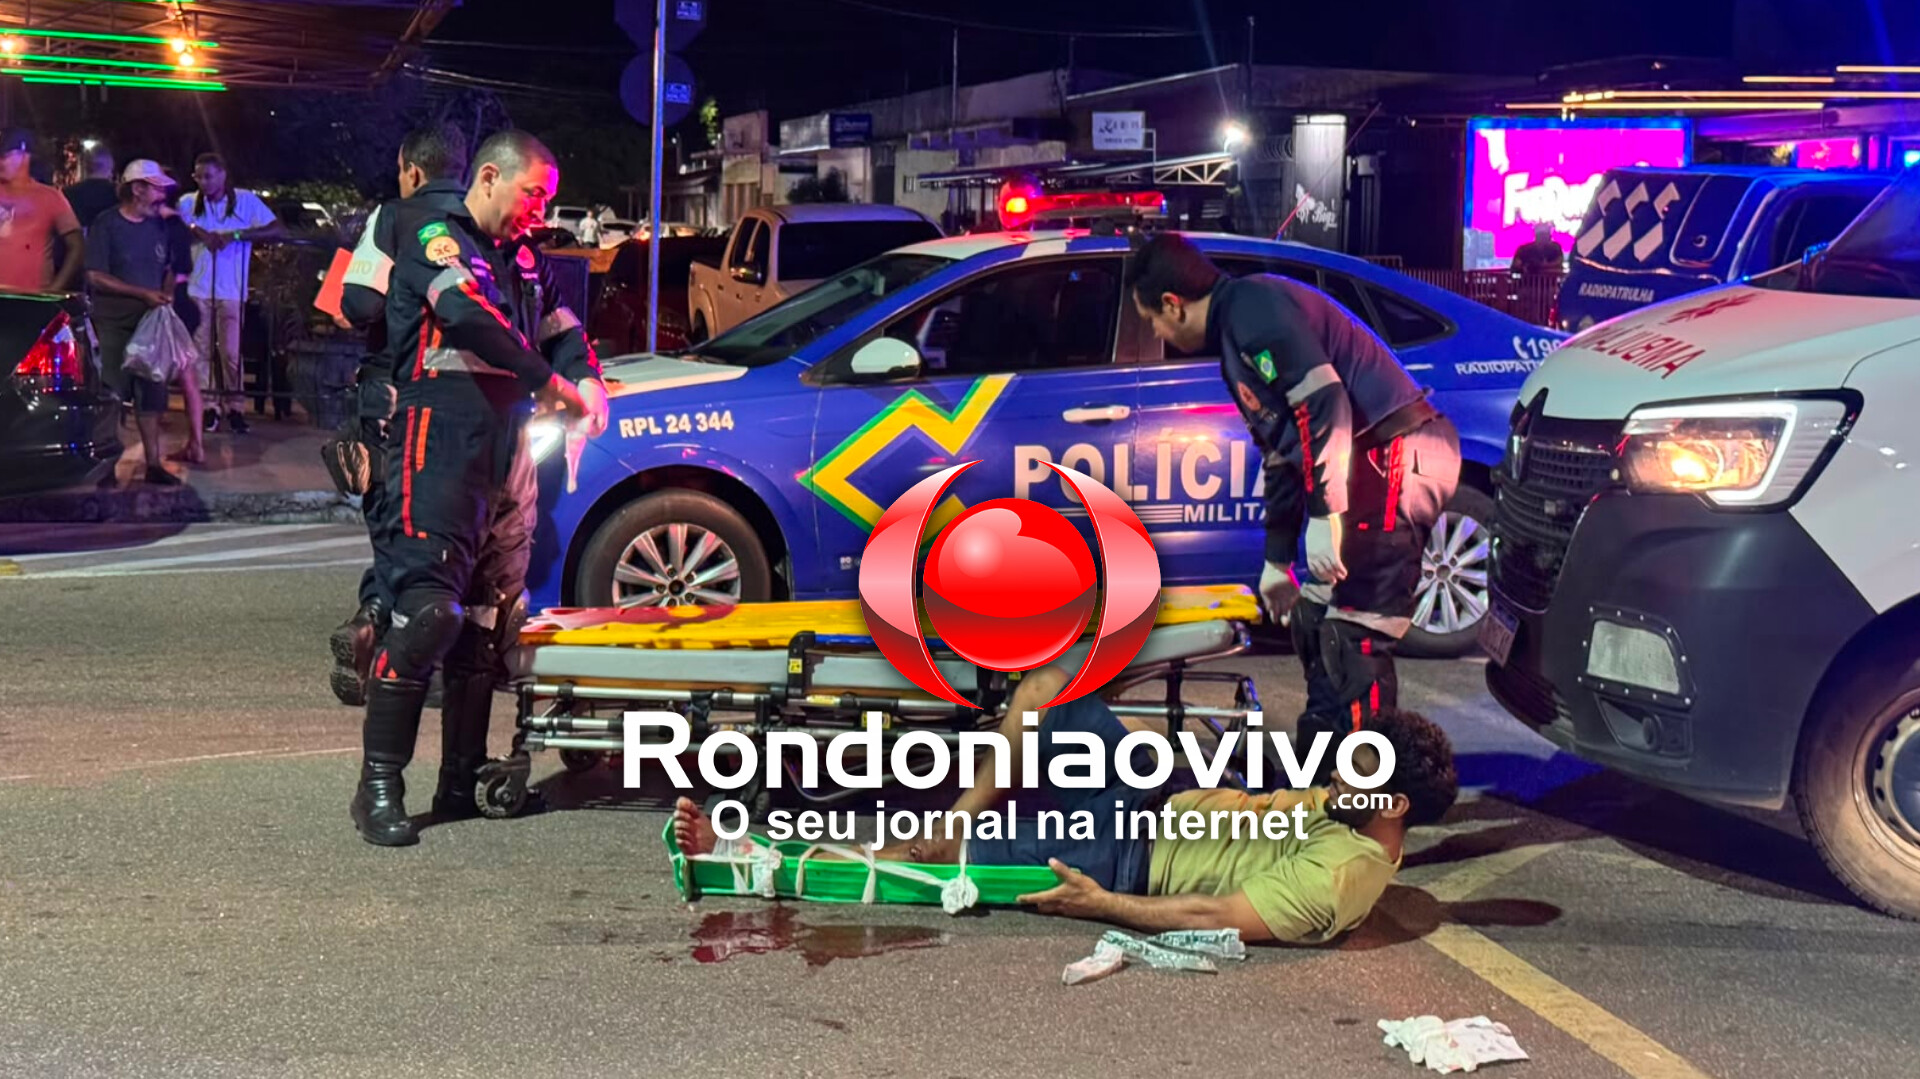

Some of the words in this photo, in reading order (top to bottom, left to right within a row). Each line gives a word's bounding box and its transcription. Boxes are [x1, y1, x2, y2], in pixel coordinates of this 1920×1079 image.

[1578, 282, 1654, 302] RADIOPATRULHA
[619, 416, 662, 438] RPL
[664, 413, 692, 434] 24
[695, 410, 734, 432] 344
